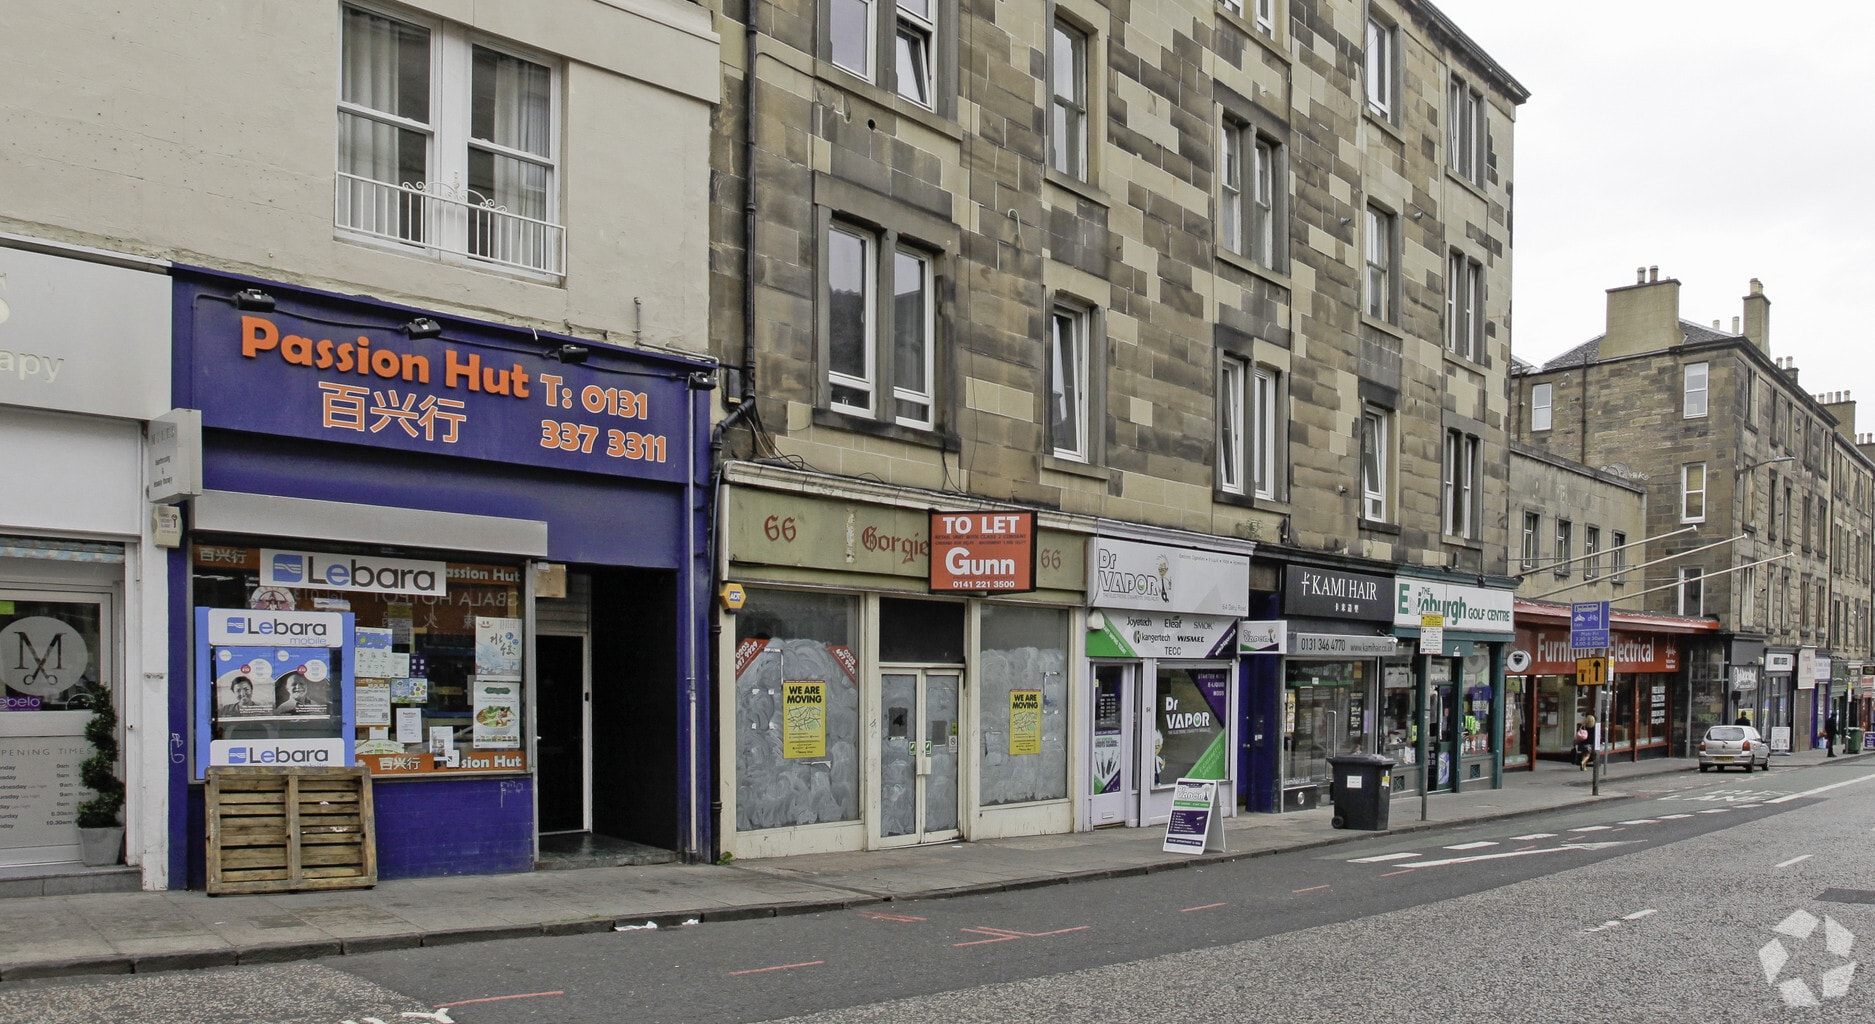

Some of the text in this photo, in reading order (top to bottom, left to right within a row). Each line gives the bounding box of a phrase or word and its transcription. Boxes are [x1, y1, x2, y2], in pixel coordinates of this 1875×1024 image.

[241, 315, 530, 399] Passion Hut
[540, 374, 648, 421] T: 0131
[318, 381, 467, 444] 百兴行
[541, 419, 667, 464] 337 3311
[764, 515, 797, 542] 66
[942, 516, 1020, 534] TO LET
[861, 526, 928, 564] Gorgie
[200, 547, 247, 564] 百兴行
[945, 546, 1015, 575] Gunn
[1041, 548, 1062, 570] 66
[1099, 548, 1117, 569] Dr
[308, 555, 436, 591] Lebara
[446, 566, 520, 582] assion Hut
[994, 580, 1014, 588] 3500
[1099, 570, 1158, 596] VAPOR
[1312, 575, 1377, 601] KAMI HAIR
[1127, 617, 1152, 627] Joyetech
[1165, 618, 1182, 629] Eleaf
[1468, 608, 1485, 620] GOLF
[1487, 609, 1510, 622] CENTRE
[248, 618, 327, 636] Lebara
[290, 636, 327, 645] mobile
[1141, 632, 1170, 643] kangertech
[1301, 638, 1346, 652] 0131 346 4770
[1165, 646, 1182, 656] TECC
[1608, 635, 1654, 663] Electrical
[788, 686, 820, 694] WE ARE
[787, 695, 822, 704] MOVING
[1012, 701, 1038, 709] MOVING
[1165, 696, 1179, 711] Dr
[1165, 711, 1210, 729] VAPOR
[249, 747, 329, 763] Lebara
[379, 757, 421, 770] 百兴行
[461, 755, 522, 769] sion Hut
